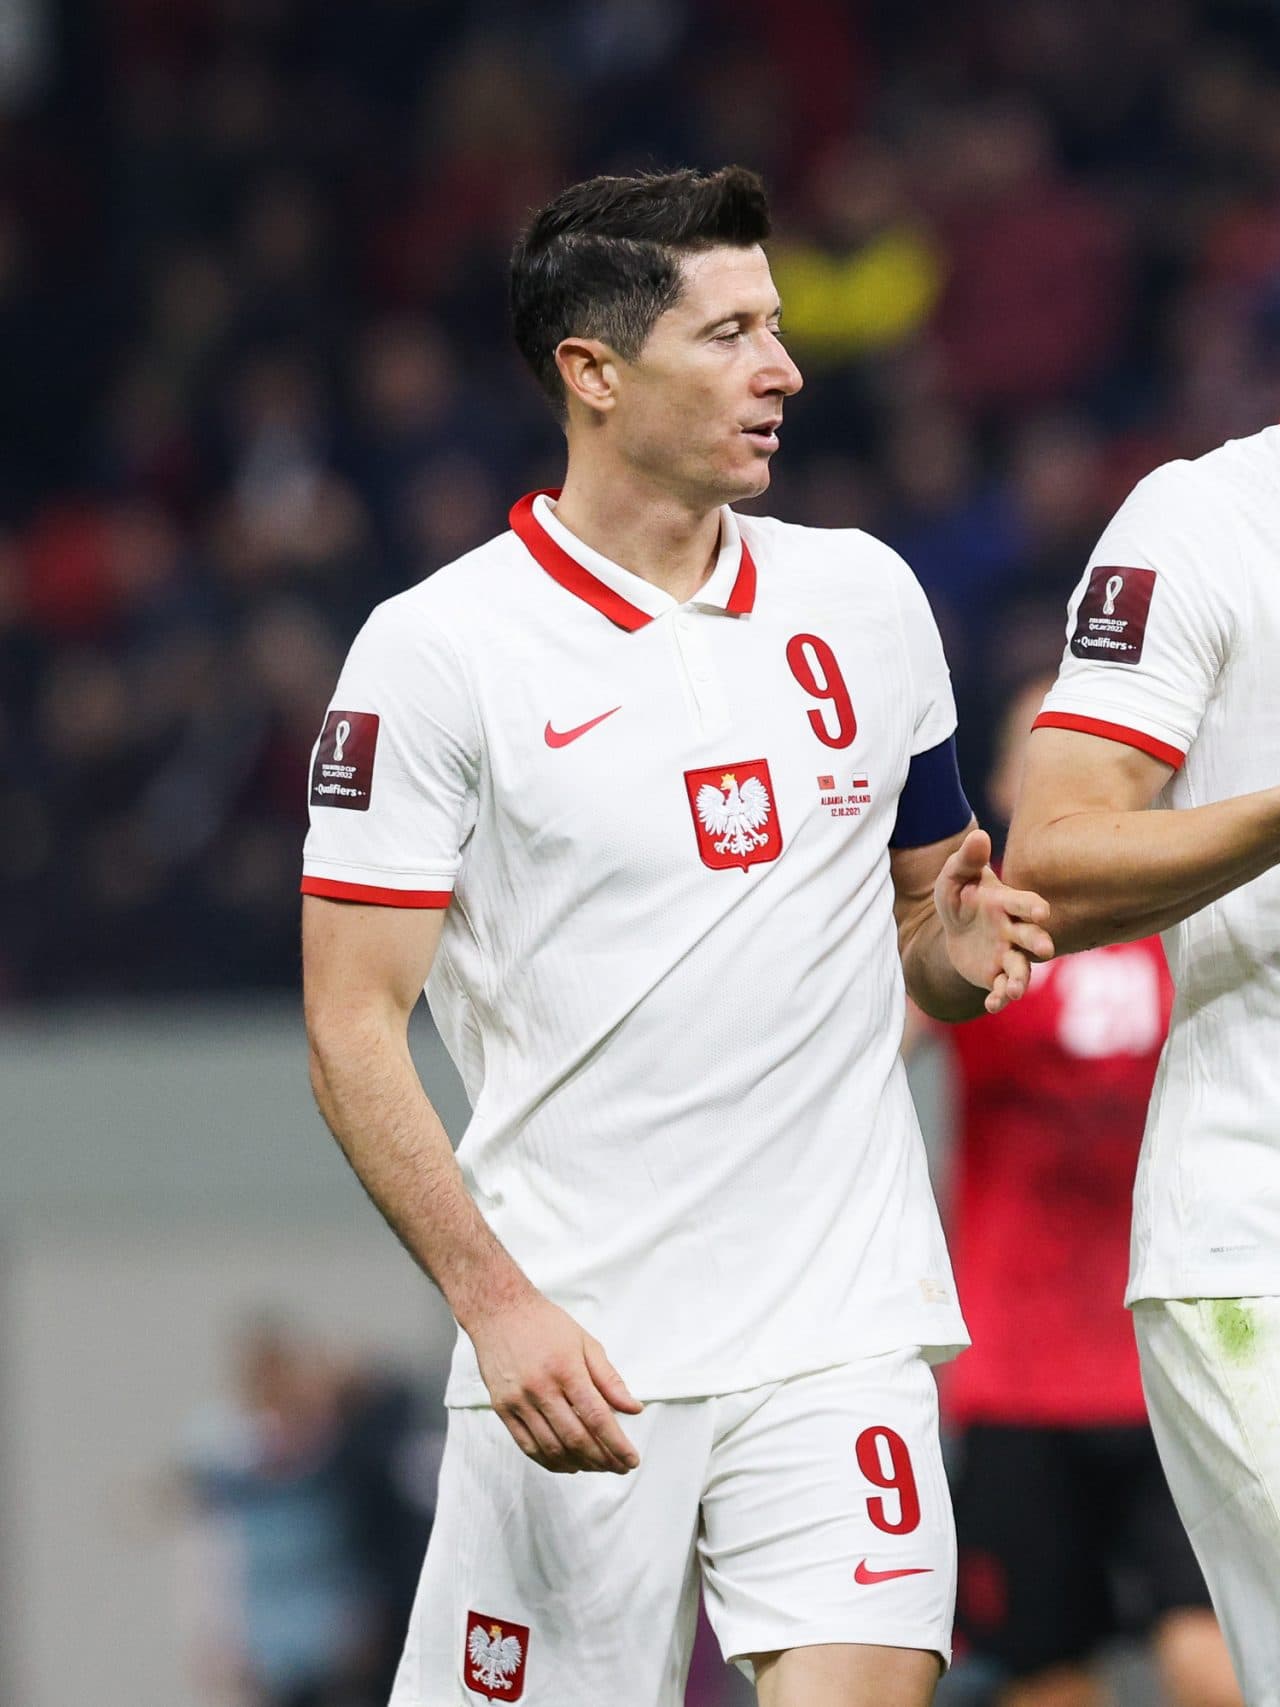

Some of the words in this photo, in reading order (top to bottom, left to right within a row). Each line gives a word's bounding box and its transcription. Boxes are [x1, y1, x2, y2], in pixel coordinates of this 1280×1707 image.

[1081, 636, 1128, 651] Qualifiers
[786, 633, 857, 750] 9
[318, 783, 357, 797] Qualifiers
[848, 794, 871, 804] POLAND
[855, 1425, 921, 1535] 9
